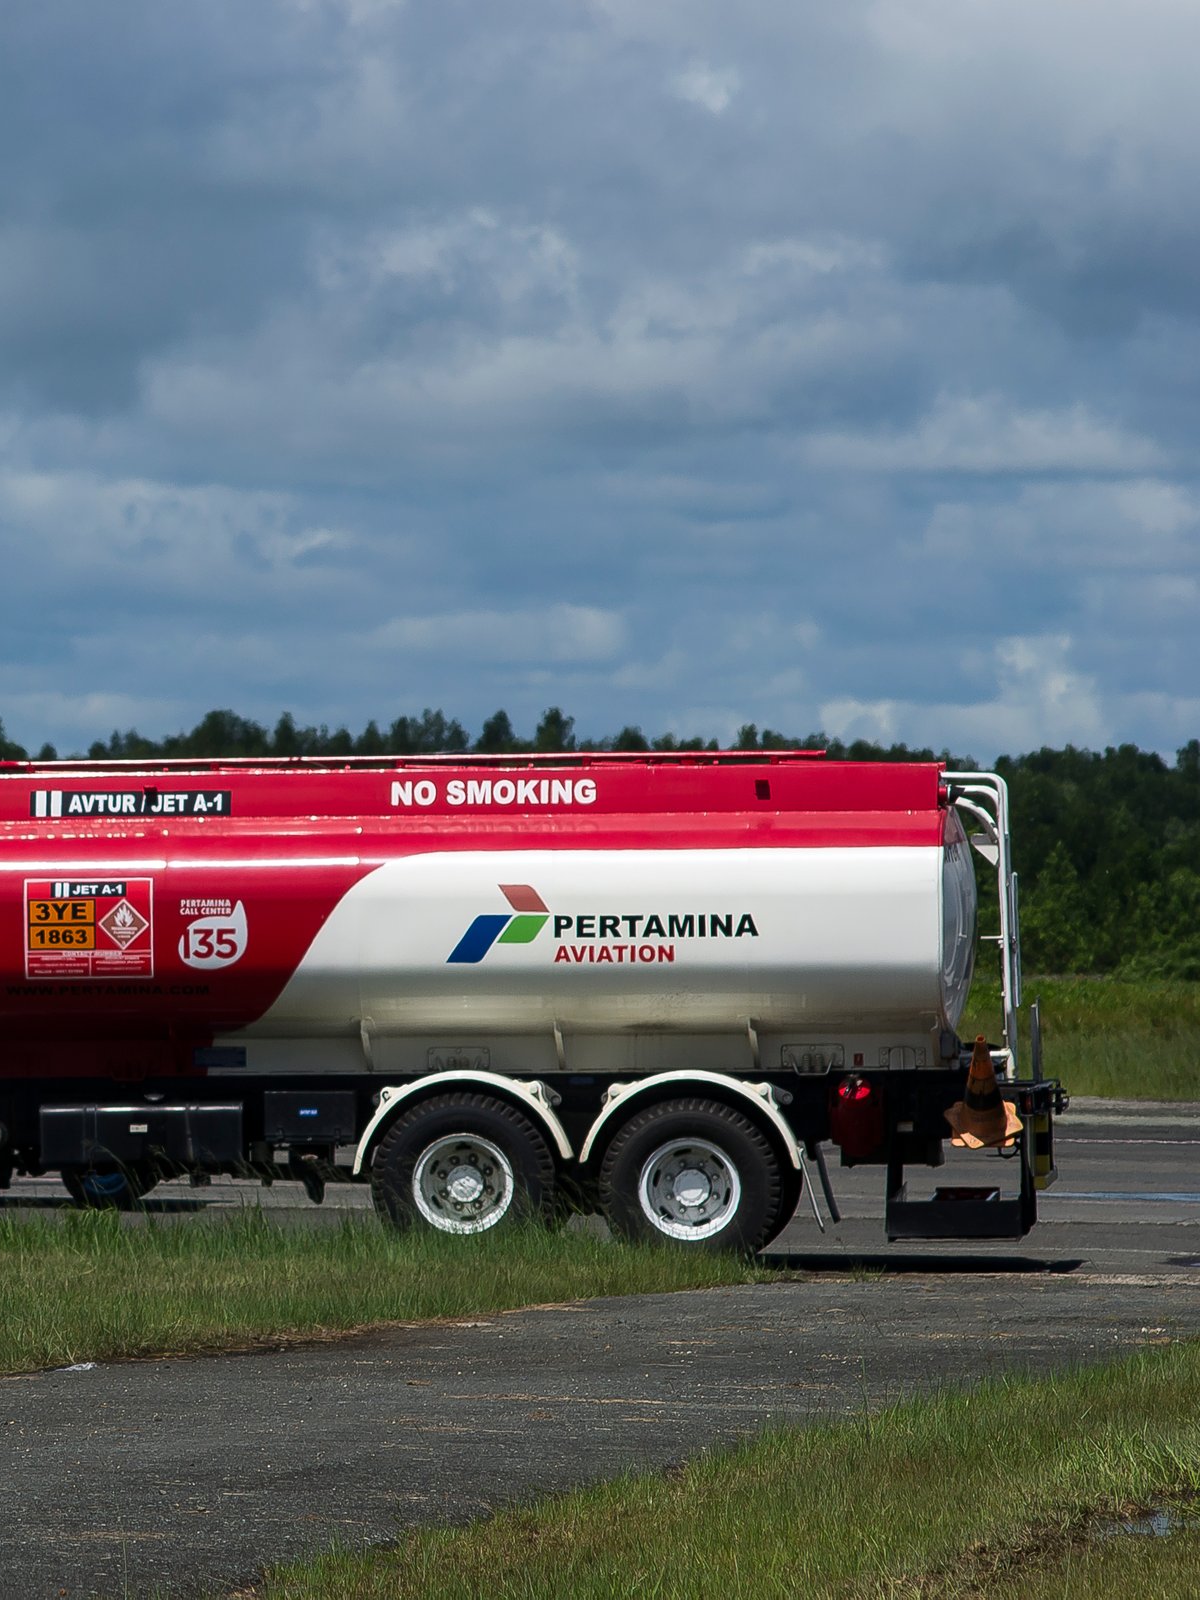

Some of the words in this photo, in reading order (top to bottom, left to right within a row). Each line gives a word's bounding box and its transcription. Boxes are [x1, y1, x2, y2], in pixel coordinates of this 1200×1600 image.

[390, 780, 437, 806] NO
[446, 778, 597, 805] SMOKING
[68, 794, 136, 813] AVTUR
[151, 794, 188, 813] JET
[193, 793, 223, 812] A-1
[72, 884, 99, 895] JET
[101, 883, 123, 895] A-1
[35, 902, 87, 921] 3YE
[179, 907, 199, 915] CALL
[200, 907, 232, 915] CENTER
[180, 899, 232, 908] PERTAMINA
[553, 914, 760, 939] PERTAMINA
[35, 929, 87, 945] 1863
[183, 928, 238, 960] 135
[553, 944, 676, 964] AVIATION
